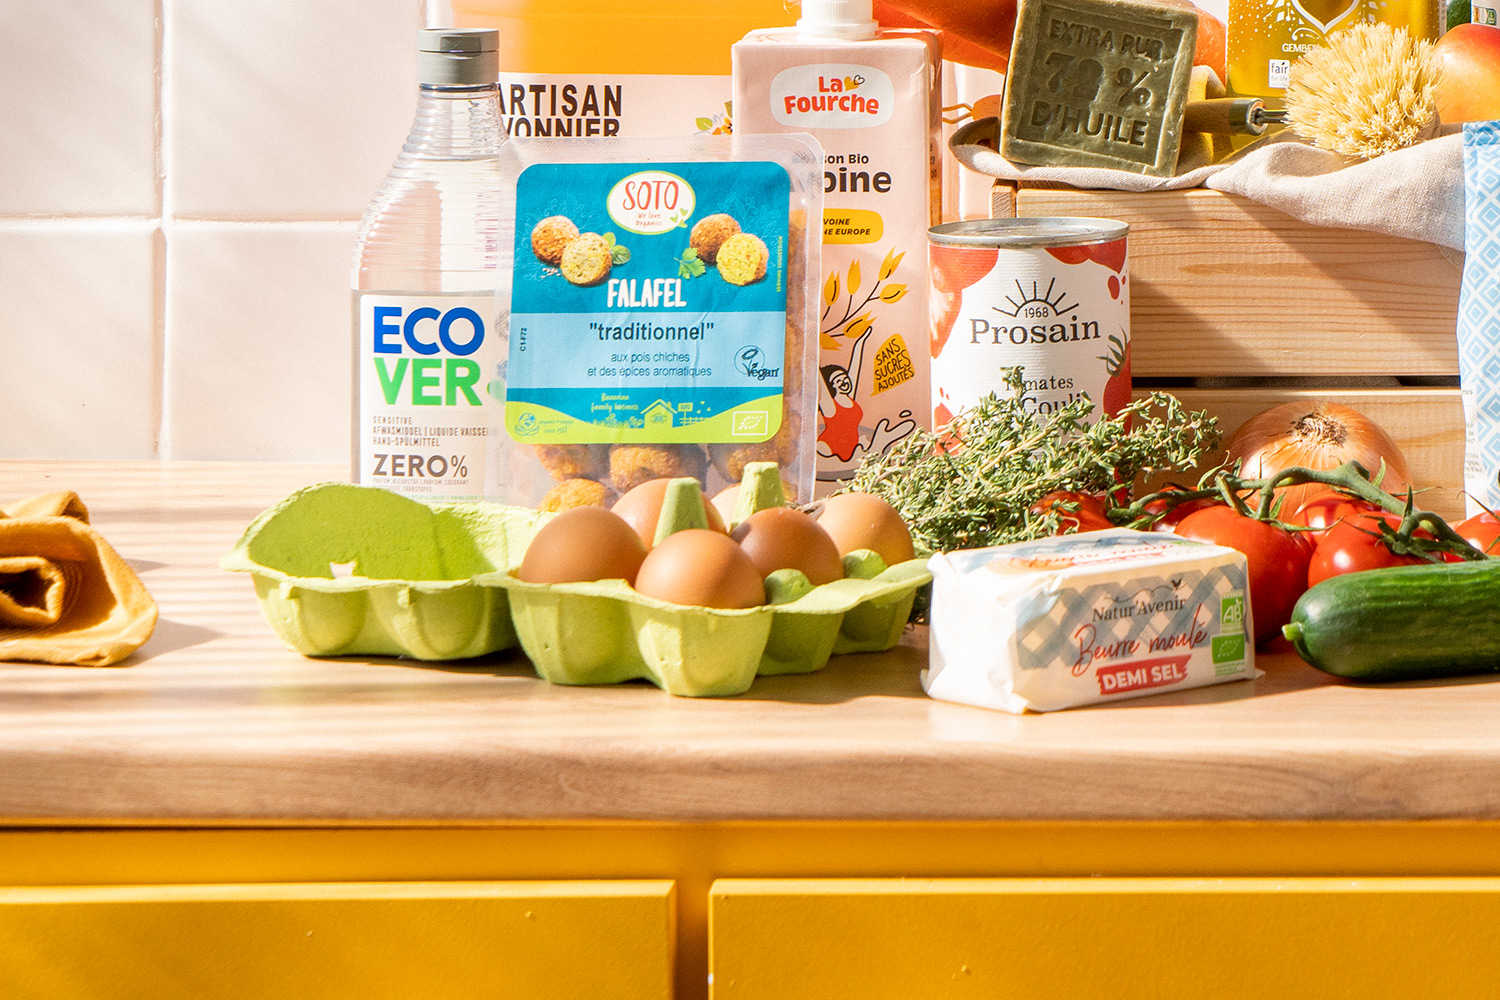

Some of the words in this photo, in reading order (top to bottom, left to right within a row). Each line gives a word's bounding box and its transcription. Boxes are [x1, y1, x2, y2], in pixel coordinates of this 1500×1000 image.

[1049, 18, 1115, 51] EXTRA
[1121, 32, 1164, 60] PUR
[1271, 61, 1288, 74] fair
[818, 75, 843, 93] La
[784, 93, 880, 115] Fourche
[1031, 100, 1148, 147] D'HUILE
[848, 153, 870, 165] Bio
[622, 180, 679, 211] SOTO
[635, 220, 663, 229] Organics
[834, 228, 871, 236] EUROPE
[606, 278, 687, 308] FALAFEL
[1024, 306, 1049, 319] 1968
[373, 306, 485, 356] ECO
[589, 322, 715, 342] "traditionnel"
[969, 314, 1101, 345] Prosain
[610, 353, 628, 363] aux
[631, 351, 652, 365] pois
[653, 351, 690, 363] chiches
[876, 338, 901, 366] SANS
[373, 357, 483, 406] VER
[587, 367, 597, 377] et
[599, 366, 617, 377] des
[620, 365, 650, 380] épices
[652, 366, 712, 380] aromatiques
[877, 365, 915, 392] AJOUTÉS
[372, 416, 413, 425] SENSITIVE
[372, 426, 423, 437] AFWASMIDDEL
[429, 427, 459, 437] LIQUIDE
[372, 453, 468, 479] ZERO%
[1092, 594, 1187, 623] Natur'Avenir
[1222, 601, 1243, 624] AB
[1071, 623, 1141, 677] Beurre
[1148, 602, 1209, 653] moulé
[1102, 668, 1148, 691] DEMI
[1150, 663, 1184, 683] SEL
